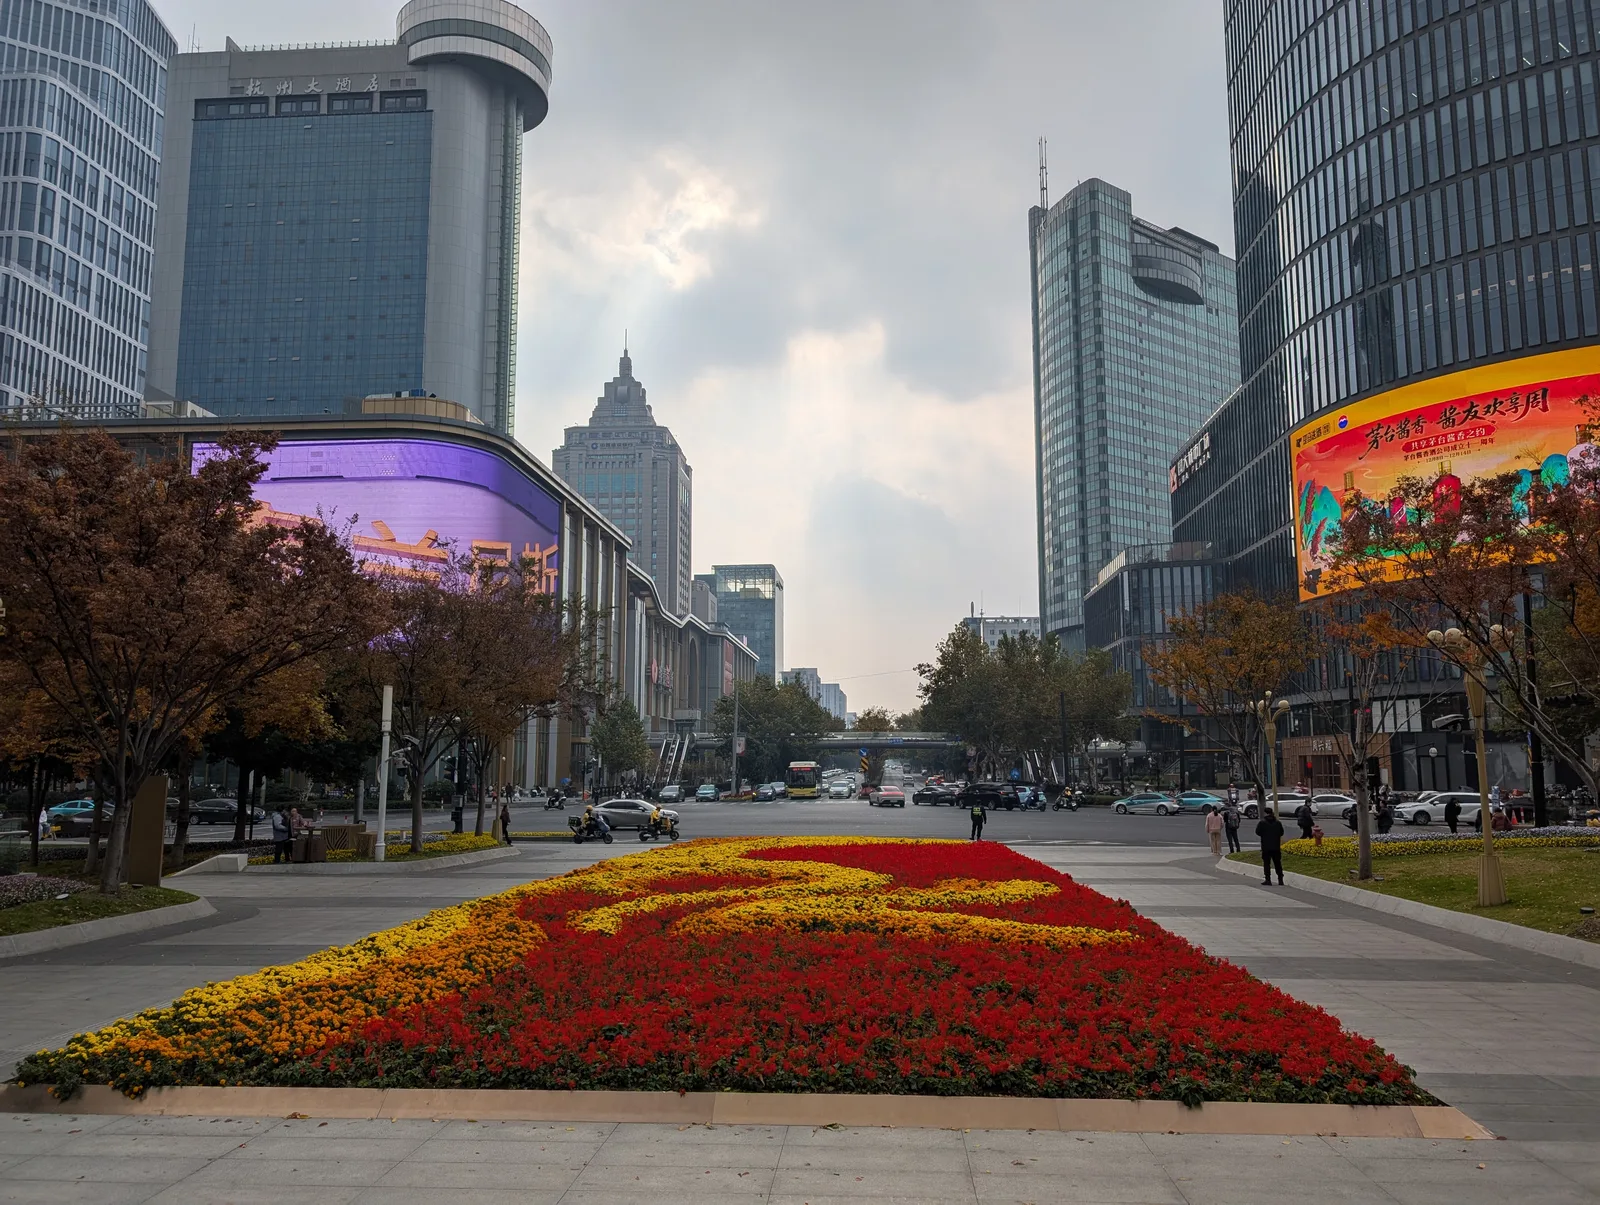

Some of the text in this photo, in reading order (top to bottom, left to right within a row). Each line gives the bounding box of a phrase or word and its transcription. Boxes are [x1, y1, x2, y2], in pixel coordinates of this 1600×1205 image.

[245, 74, 380, 96] 杭州大酒店
